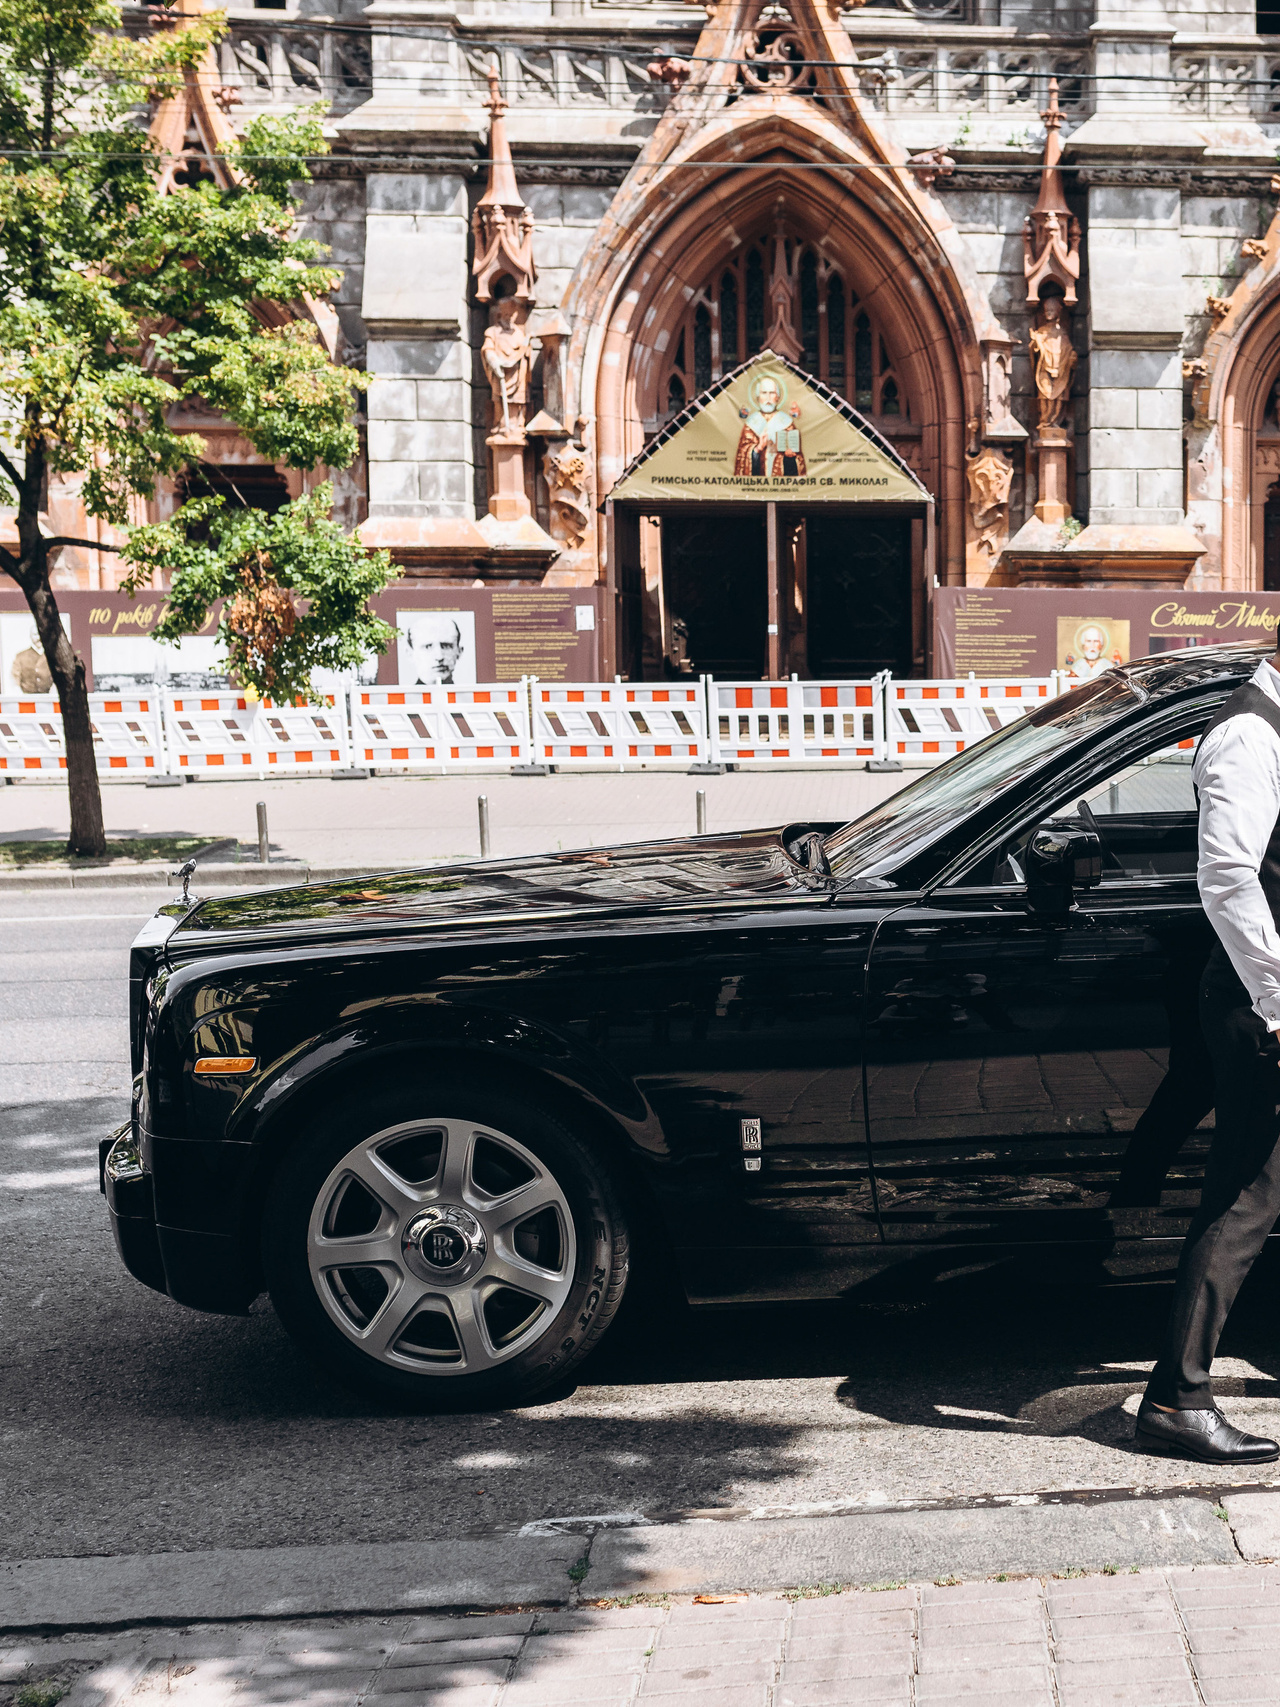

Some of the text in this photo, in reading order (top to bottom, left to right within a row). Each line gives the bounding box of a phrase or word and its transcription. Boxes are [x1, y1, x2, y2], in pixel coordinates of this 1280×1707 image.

[651, 476, 888, 486] РИМСЬКО-КАТОЛИЦЬКА ПАРАФІЯ СВ. МИКОЛАЯ
[112, 603, 158, 634] років
[1150, 600, 1280, 633] Святий Микол
[432, 1233, 454, 1261] RR
[577, 1264, 607, 1333] NCT
